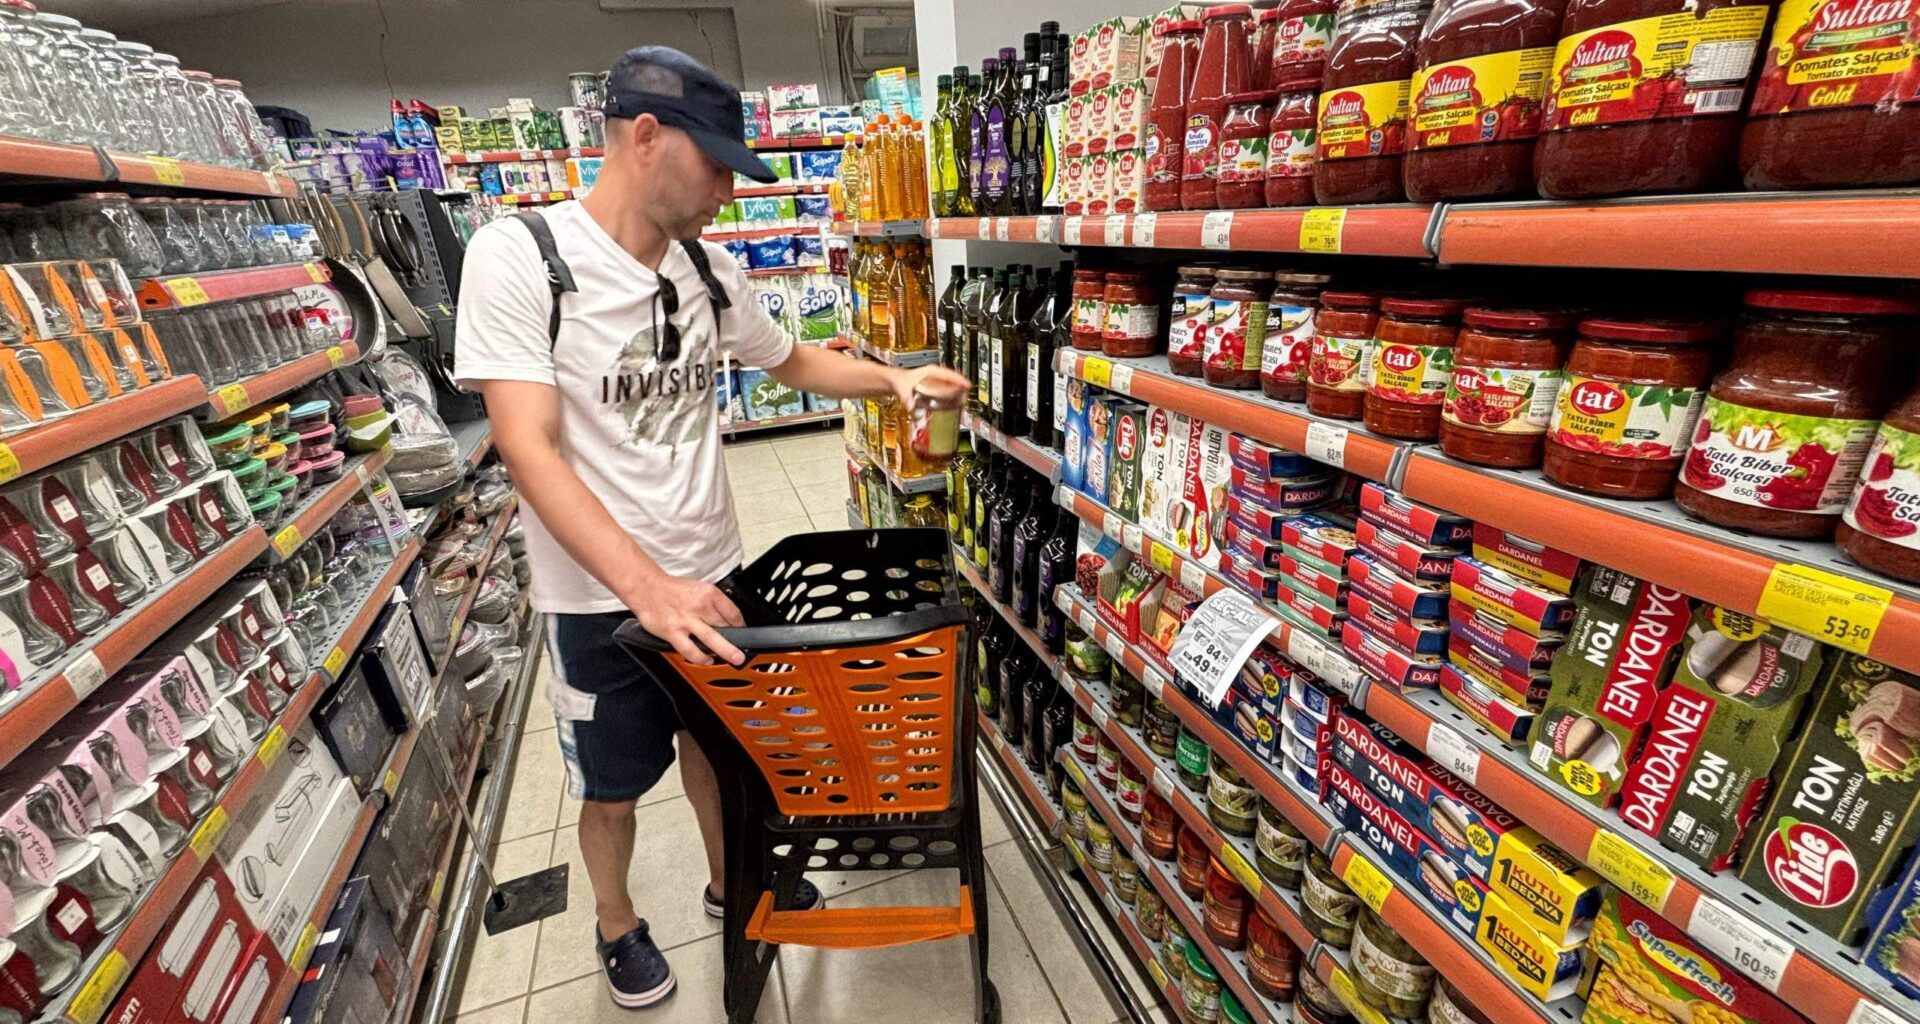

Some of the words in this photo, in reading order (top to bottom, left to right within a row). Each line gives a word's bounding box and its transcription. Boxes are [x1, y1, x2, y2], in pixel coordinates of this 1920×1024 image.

[1814, 0, 1910, 31] Sultan
[1283, 23, 1299, 36] tat
[1572, 40, 1630, 67] Sultan
[1794, 56, 1849, 73] Domates
[1425, 74, 1470, 97] Sultan
[1806, 69, 1844, 81] Tomato
[1846, 65, 1878, 76] Paste
[1560, 84, 1594, 99] Domates
[1808, 83, 1857, 107] Gold
[1327, 99, 1361, 114] Sultan
[1570, 108, 1599, 124] Gold
[1222, 146, 1238, 157] tat
[1273, 137, 1289, 149] tat
[1328, 145, 1345, 158] Gold
[1427, 132, 1450, 146] Gold
[799, 288, 837, 317] Solo
[1386, 348, 1417, 368] tat
[1575, 386, 1615, 411] tat
[1566, 412, 1589, 425] TATLI
[1591, 415, 1616, 430] BİBER
[1570, 422, 1604, 437] SALÇASI
[1156, 453, 1165, 481] TON
[1177, 441, 1187, 469] TON
[1184, 416, 1201, 499] DARDANEL
[1705, 446, 1738, 465] Tatlı
[1740, 455, 1794, 476] Biber
[1126, 464, 1134, 490] TON
[1710, 464, 1772, 486] Salçası
[1379, 505, 1411, 524] DARDANEL
[1371, 540, 1398, 560] DARDANEL
[1498, 544, 1543, 566] DARDANEL
[1128, 562, 1148, 581] TON
[1527, 569, 1543, 578] TON
[1474, 583, 1514, 608] DARDANEL
[1097, 601, 1130, 638] DARDANEL
[1500, 609, 1515, 619] TON
[1469, 619, 1505, 645] DARDANEL
[1584, 620, 1620, 668] TON
[1497, 647, 1512, 659] TON
[1603, 583, 1682, 719] DARDANEL
[1468, 653, 1503, 680] DARDANEL
[1744, 645, 1777, 697] DARDANEL
[1769, 667, 1787, 689] TON
[1457, 691, 1490, 718] DARDANEL
[1547, 721, 1558, 737] TON
[1336, 715, 1427, 801] DARDANEL
[1624, 694, 1708, 832] DARDANEL
[1368, 765, 1404, 803] TON
[1687, 750, 1729, 801] TON
[1792, 754, 1847, 815] TON
[1330, 766, 1417, 853] DARDANEL
[1831, 772, 1864, 825] ZEYTİNYAĞLI
[1845, 797, 1870, 832] KATKISIZ
[1360, 815, 1395, 856] TON
[1498, 857, 1513, 885] 1
[1512, 864, 1562, 906] KUTU
[1510, 879, 1560, 922] BEDAVA
[1485, 915, 1498, 941] 1
[1498, 922, 1545, 965] KUTU
[1496, 934, 1543, 980] BEDAVA
[1626, 919, 1736, 1006] SuperFresh
